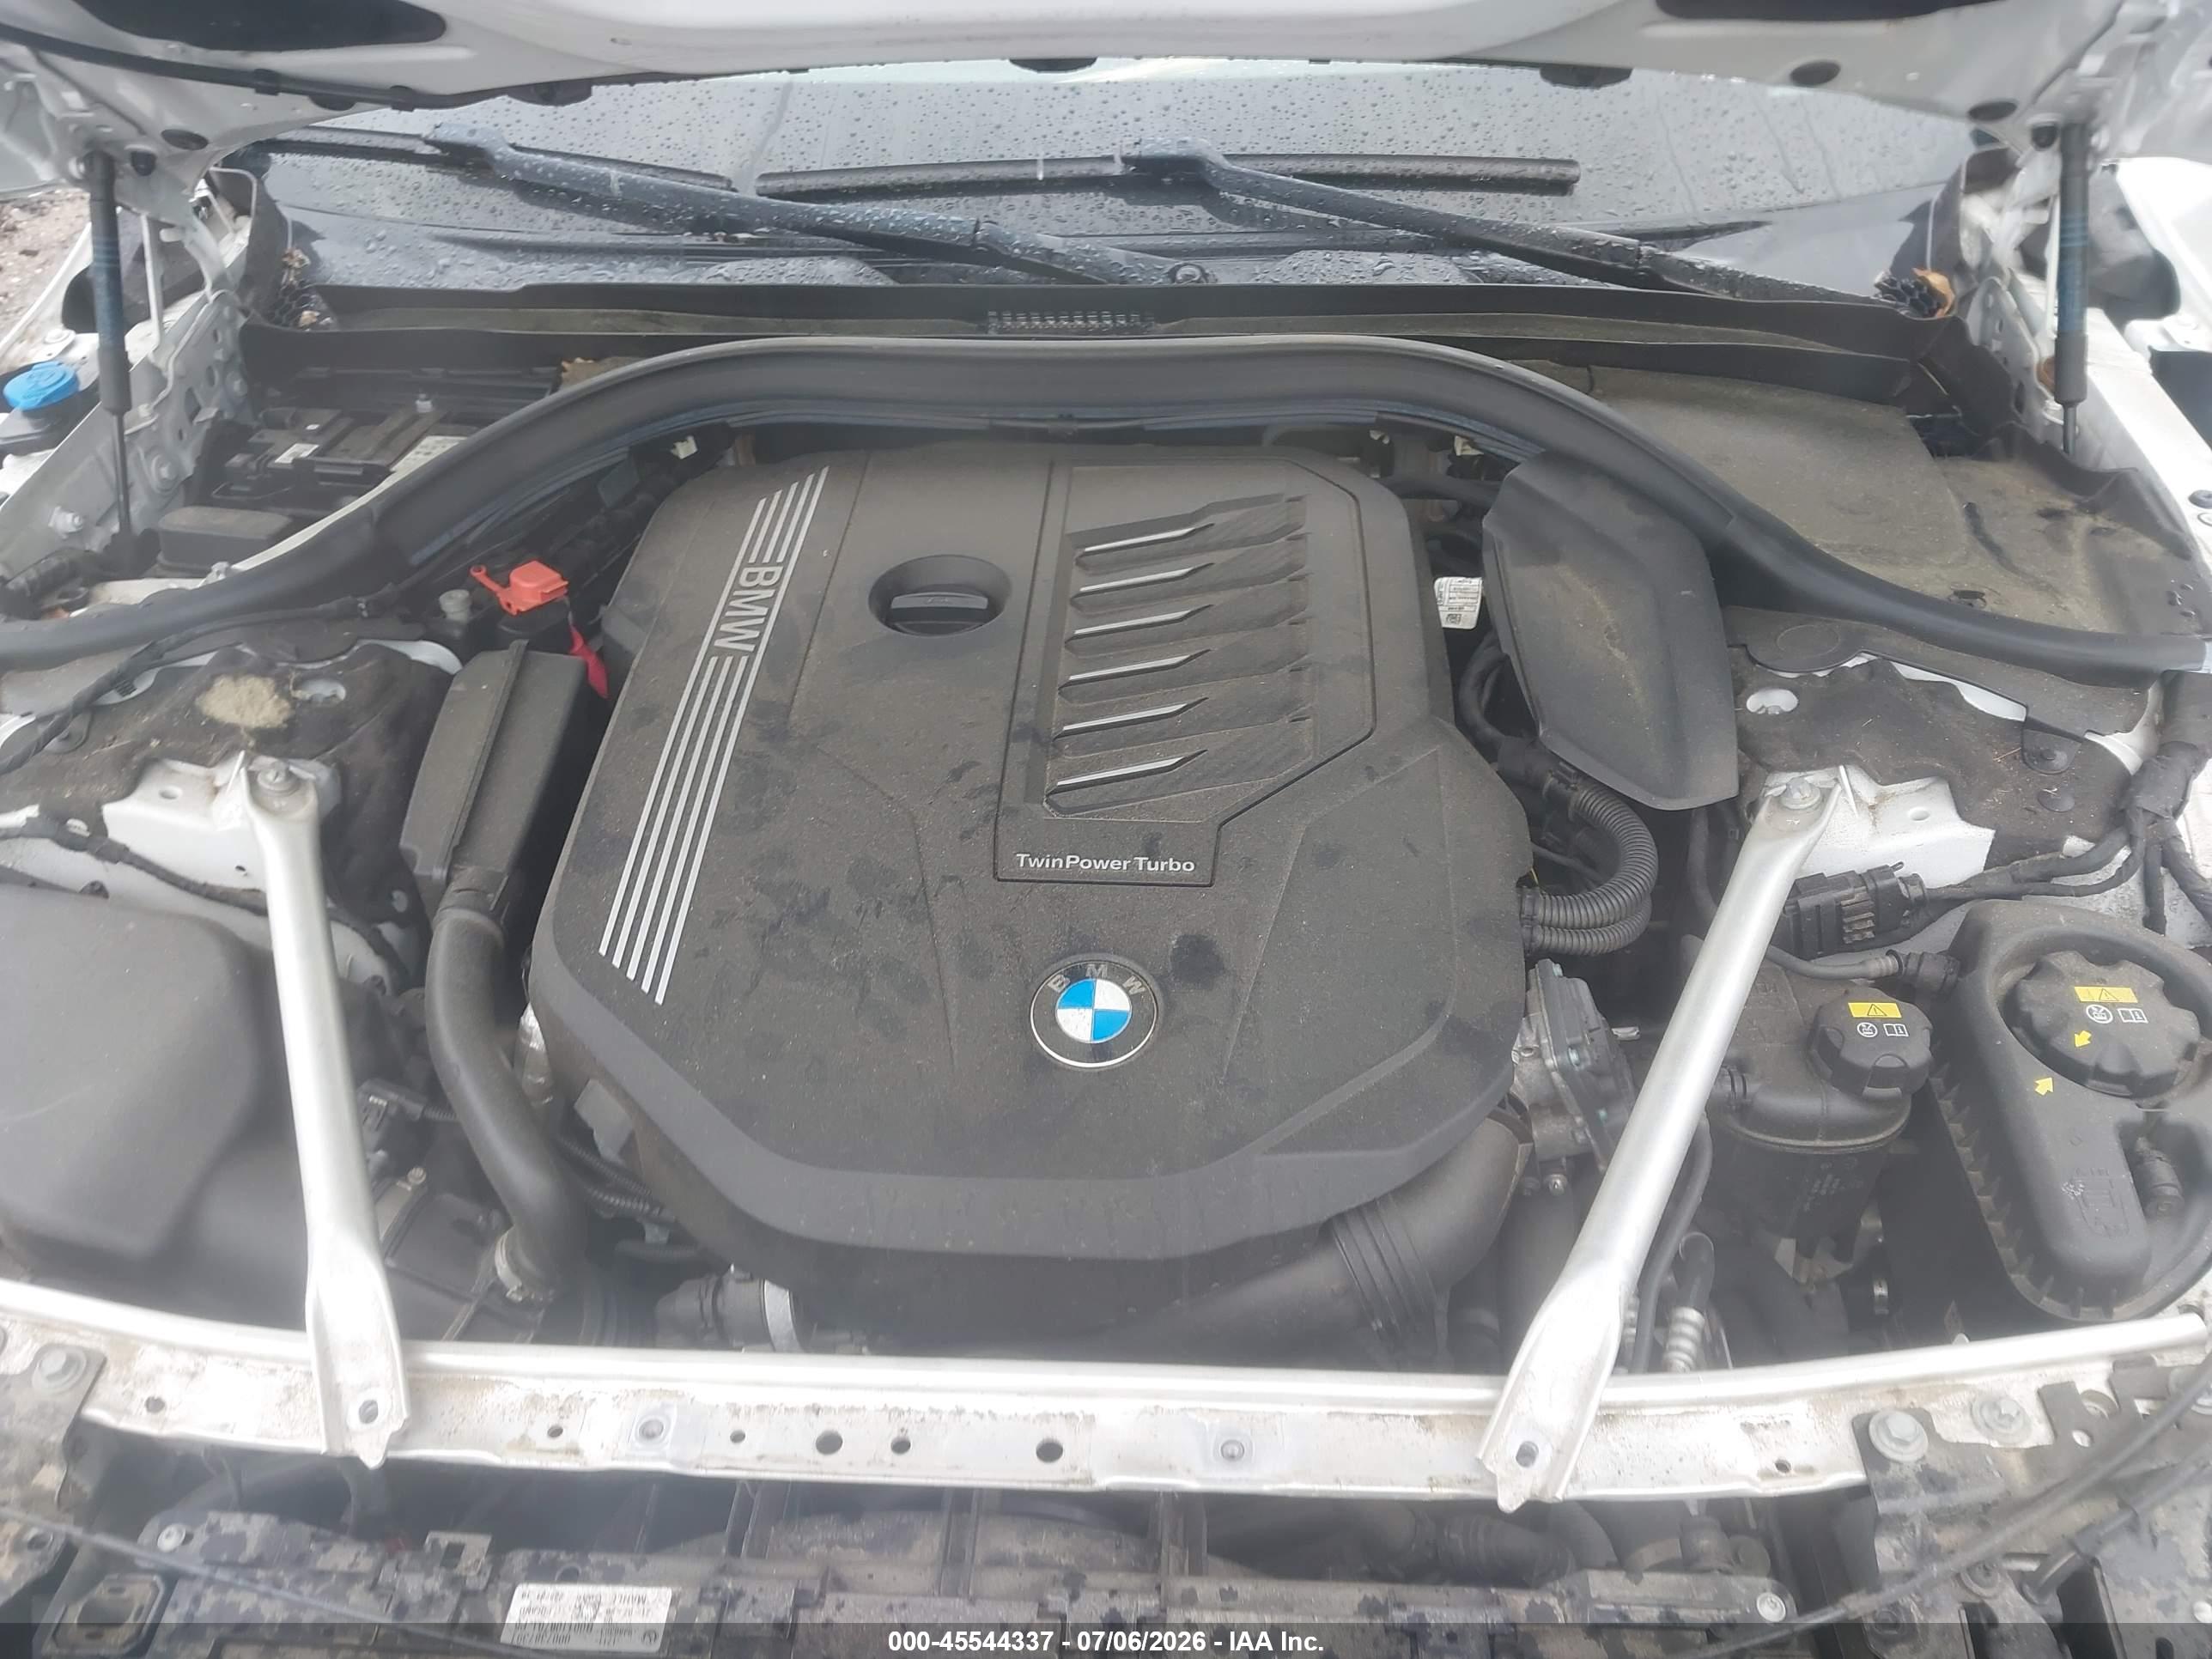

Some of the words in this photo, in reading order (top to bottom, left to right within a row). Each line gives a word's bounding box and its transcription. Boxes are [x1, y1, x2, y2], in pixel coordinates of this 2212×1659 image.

[714, 566, 783, 652] BMW
[1133, 857, 1195, 872] Turbo
[1047, 963, 1146, 994] BMW
